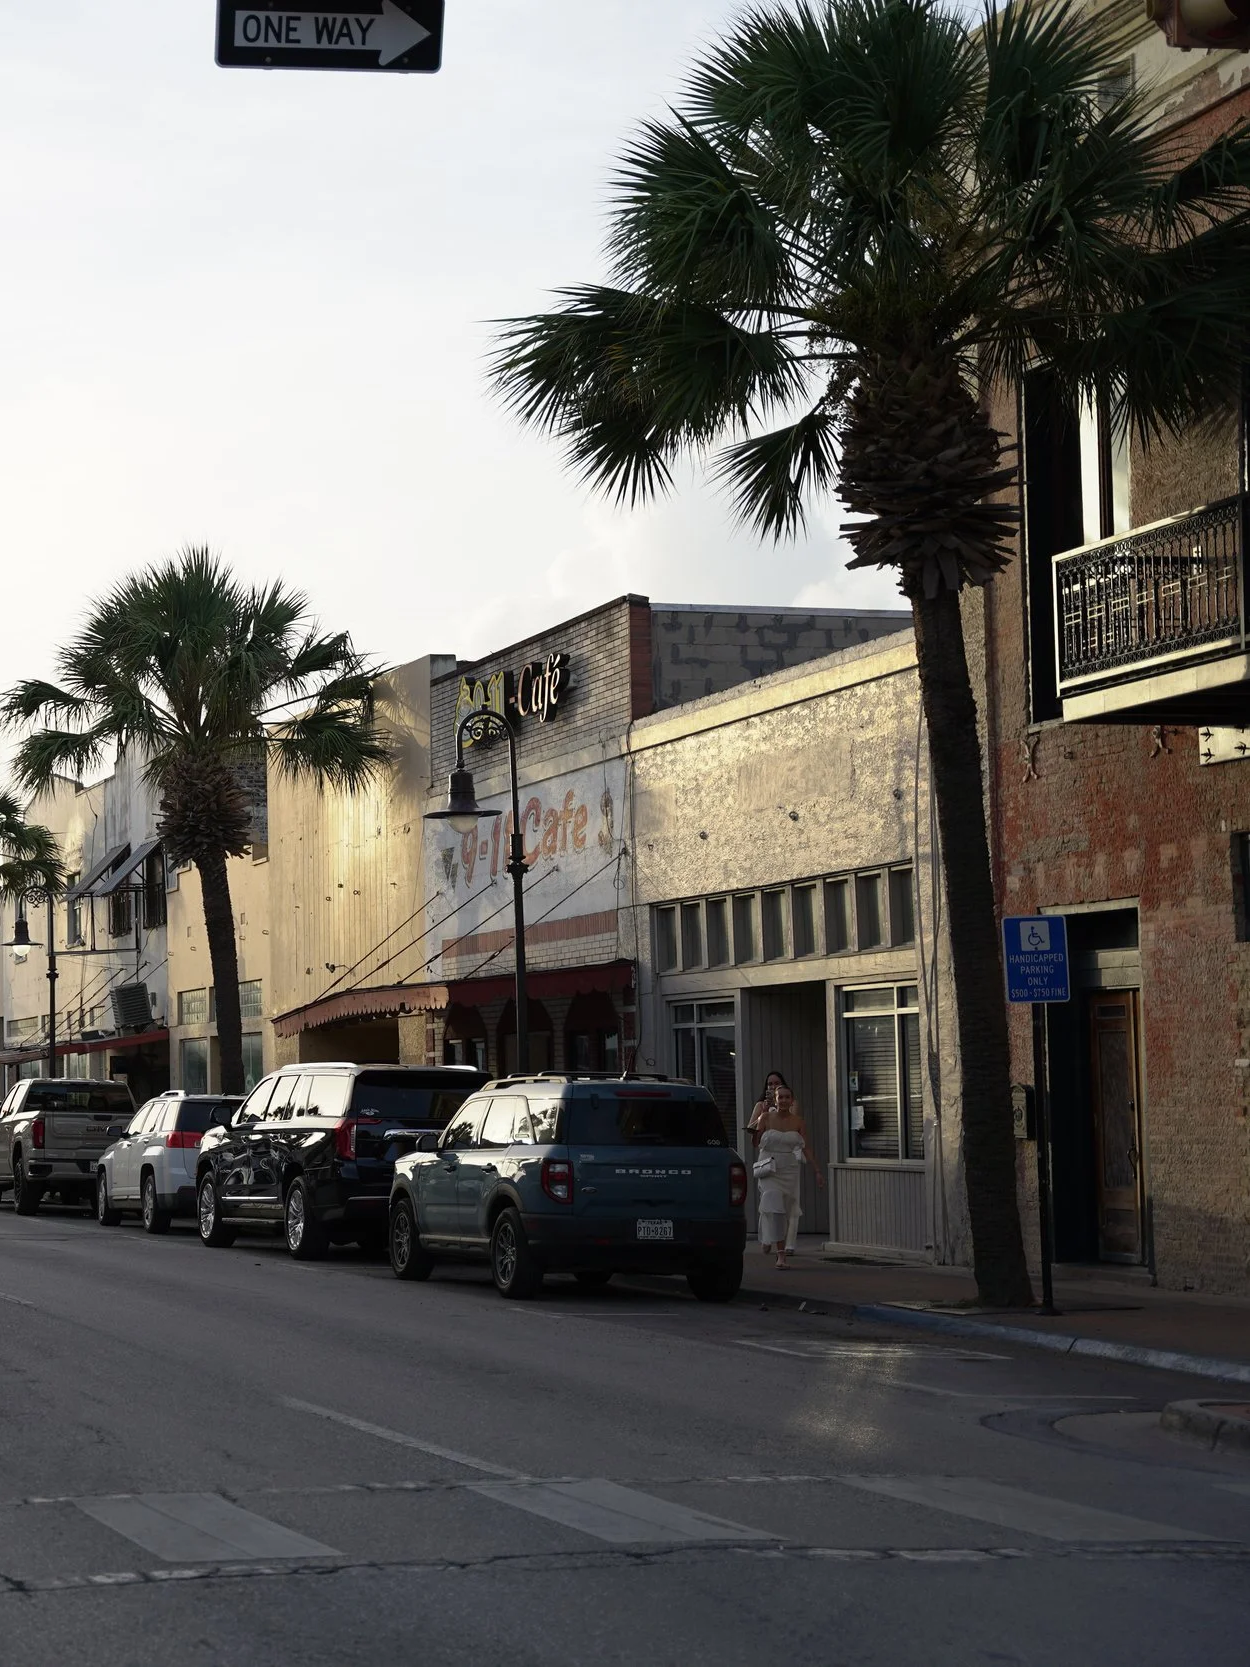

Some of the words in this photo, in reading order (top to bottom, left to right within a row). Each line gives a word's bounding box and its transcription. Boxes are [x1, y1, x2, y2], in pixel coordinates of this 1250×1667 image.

[243, 15, 301, 43] ONE
[314, 17, 376, 46] WAY
[520, 789, 588, 868] Cafe
[1009, 953, 1064, 963] HANDICAPPED
[1020, 965, 1054, 974] PARKING
[1027, 976, 1048, 986] ONLY
[1051, 987, 1066, 996] FINE
